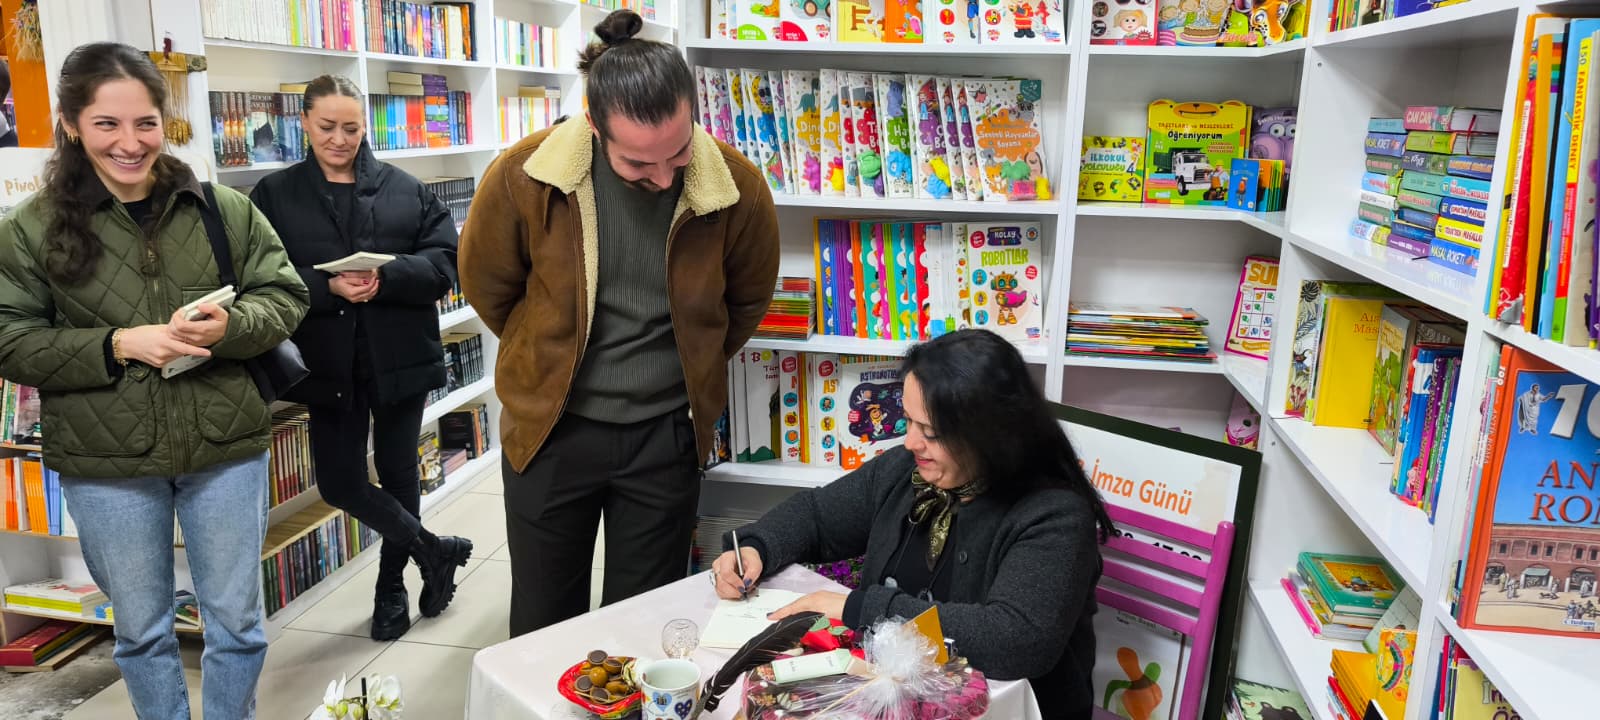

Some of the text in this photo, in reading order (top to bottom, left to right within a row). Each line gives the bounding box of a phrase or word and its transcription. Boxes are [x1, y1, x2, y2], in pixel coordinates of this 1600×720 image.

[1579, 45, 1589, 65] 150
[1167, 129, 1223, 142] Öğreniyorum
[1568, 134, 1580, 170] DENEY
[981, 248, 1029, 267] ROBOTLAR
[1091, 458, 1193, 516] İmza Günü
[1528, 492, 1600, 525] RO
